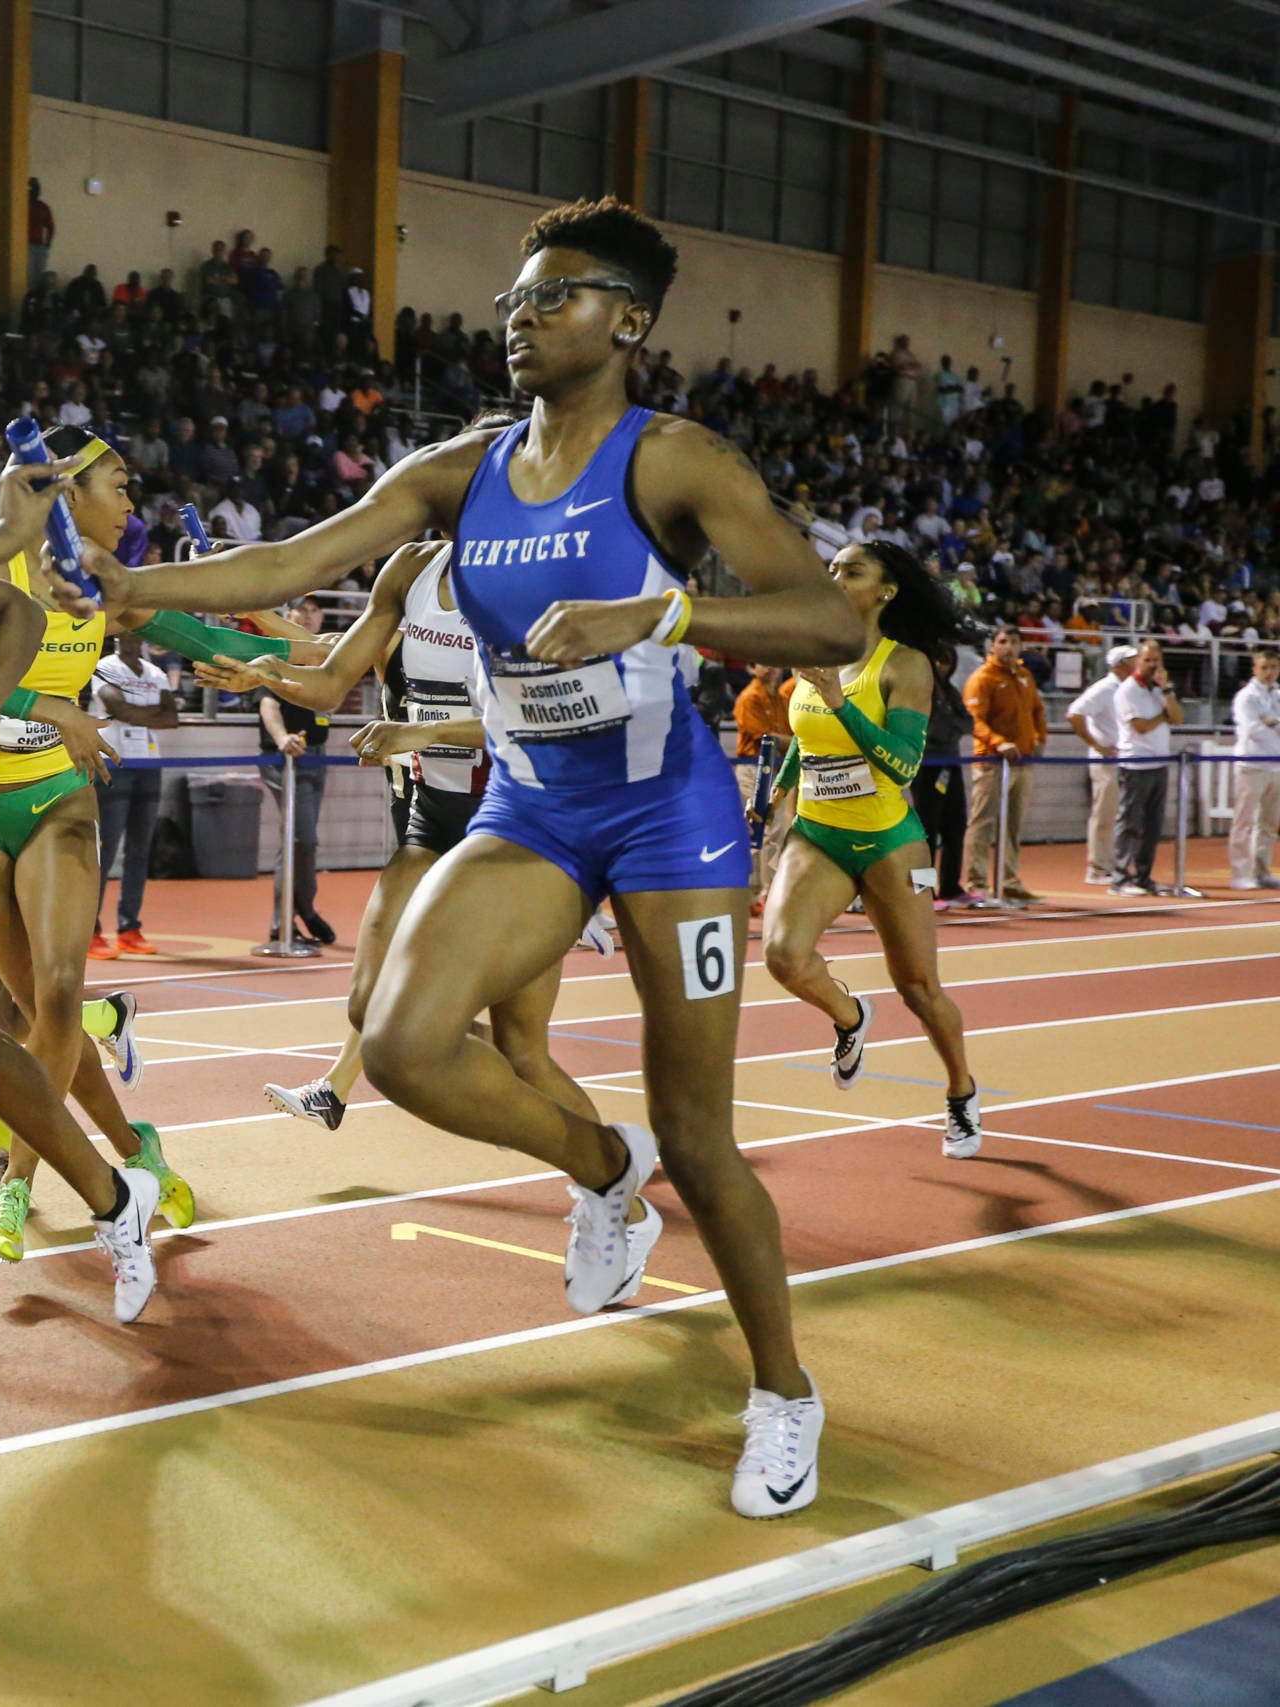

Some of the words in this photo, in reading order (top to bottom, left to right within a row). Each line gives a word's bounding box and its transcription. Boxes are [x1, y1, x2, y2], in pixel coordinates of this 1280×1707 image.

[459, 530, 591, 567] KENTUCKY
[39, 641, 98, 653] REGON
[406, 622, 475, 651] ARKANSAS
[521, 678, 584, 699] Jasmine
[417, 708, 450, 722] Monisa
[520, 695, 599, 724] Mitchell
[814, 782, 861, 797] Johnson
[695, 921, 725, 992] 6
